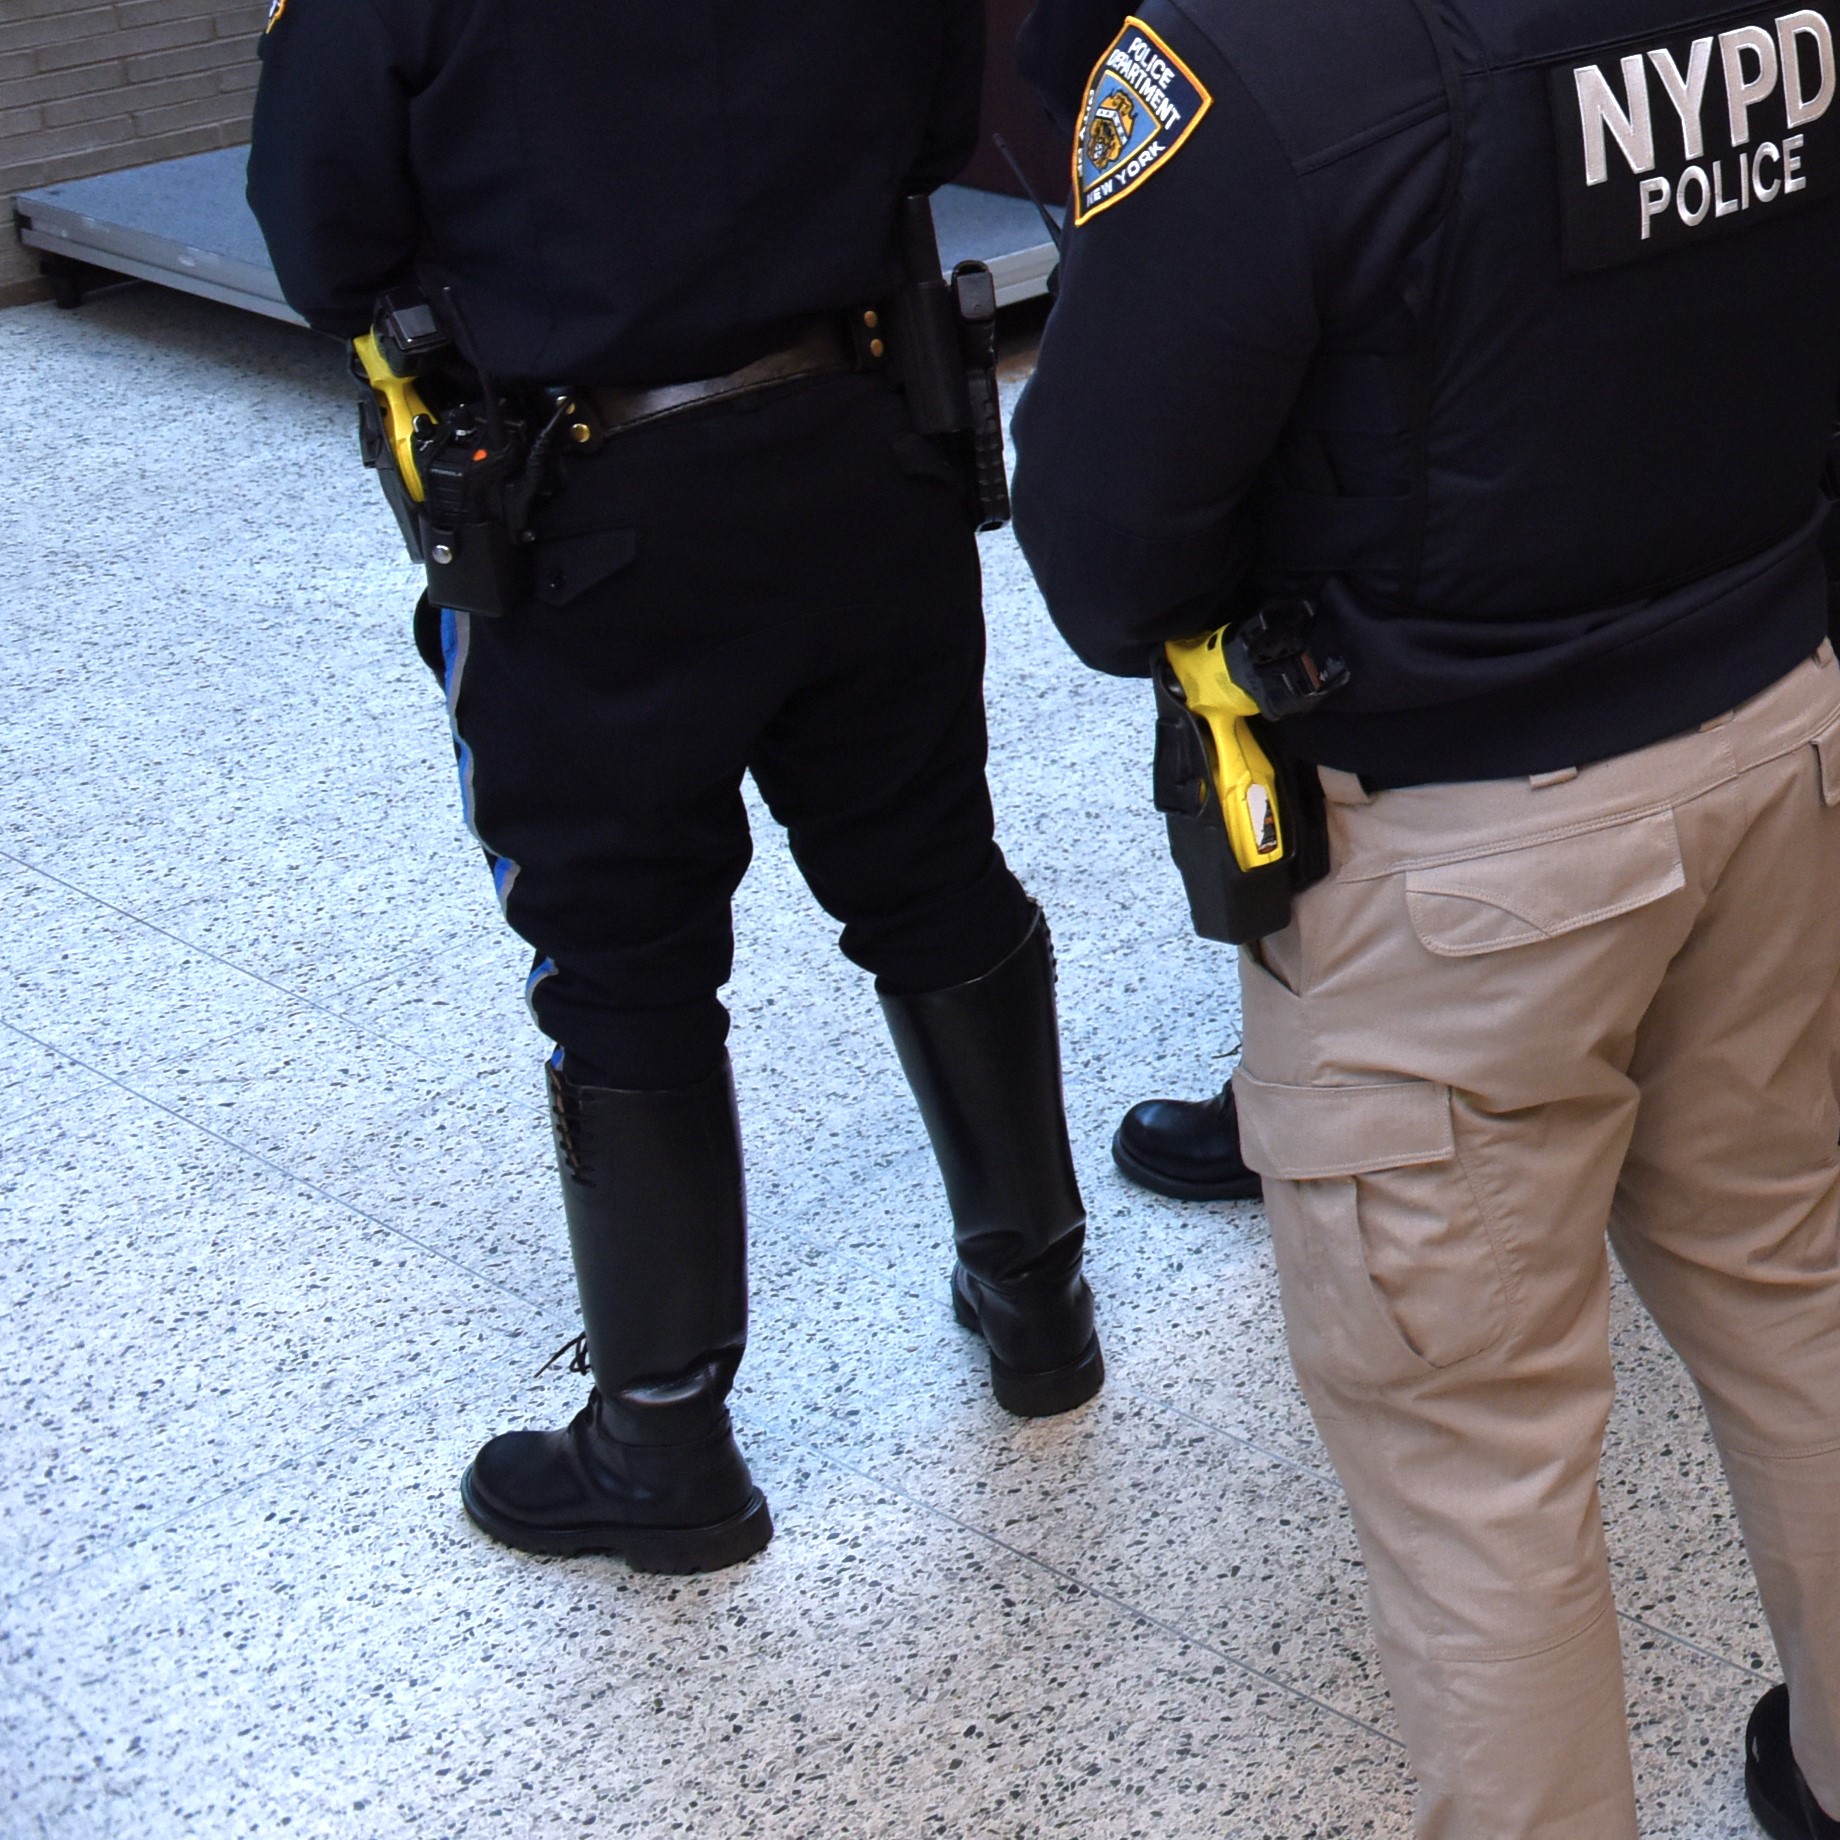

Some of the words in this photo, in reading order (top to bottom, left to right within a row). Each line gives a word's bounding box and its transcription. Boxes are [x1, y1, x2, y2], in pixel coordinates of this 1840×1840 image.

[1106, 48, 1181, 130] DEPARTMENT
[1127, 37, 1175, 88] POLICE
[1573, 8, 1837, 187] NYPD
[1086, 178, 1113, 207] NEW
[1114, 140, 1166, 186] YORK
[1640, 133, 1807, 240] POLICE
